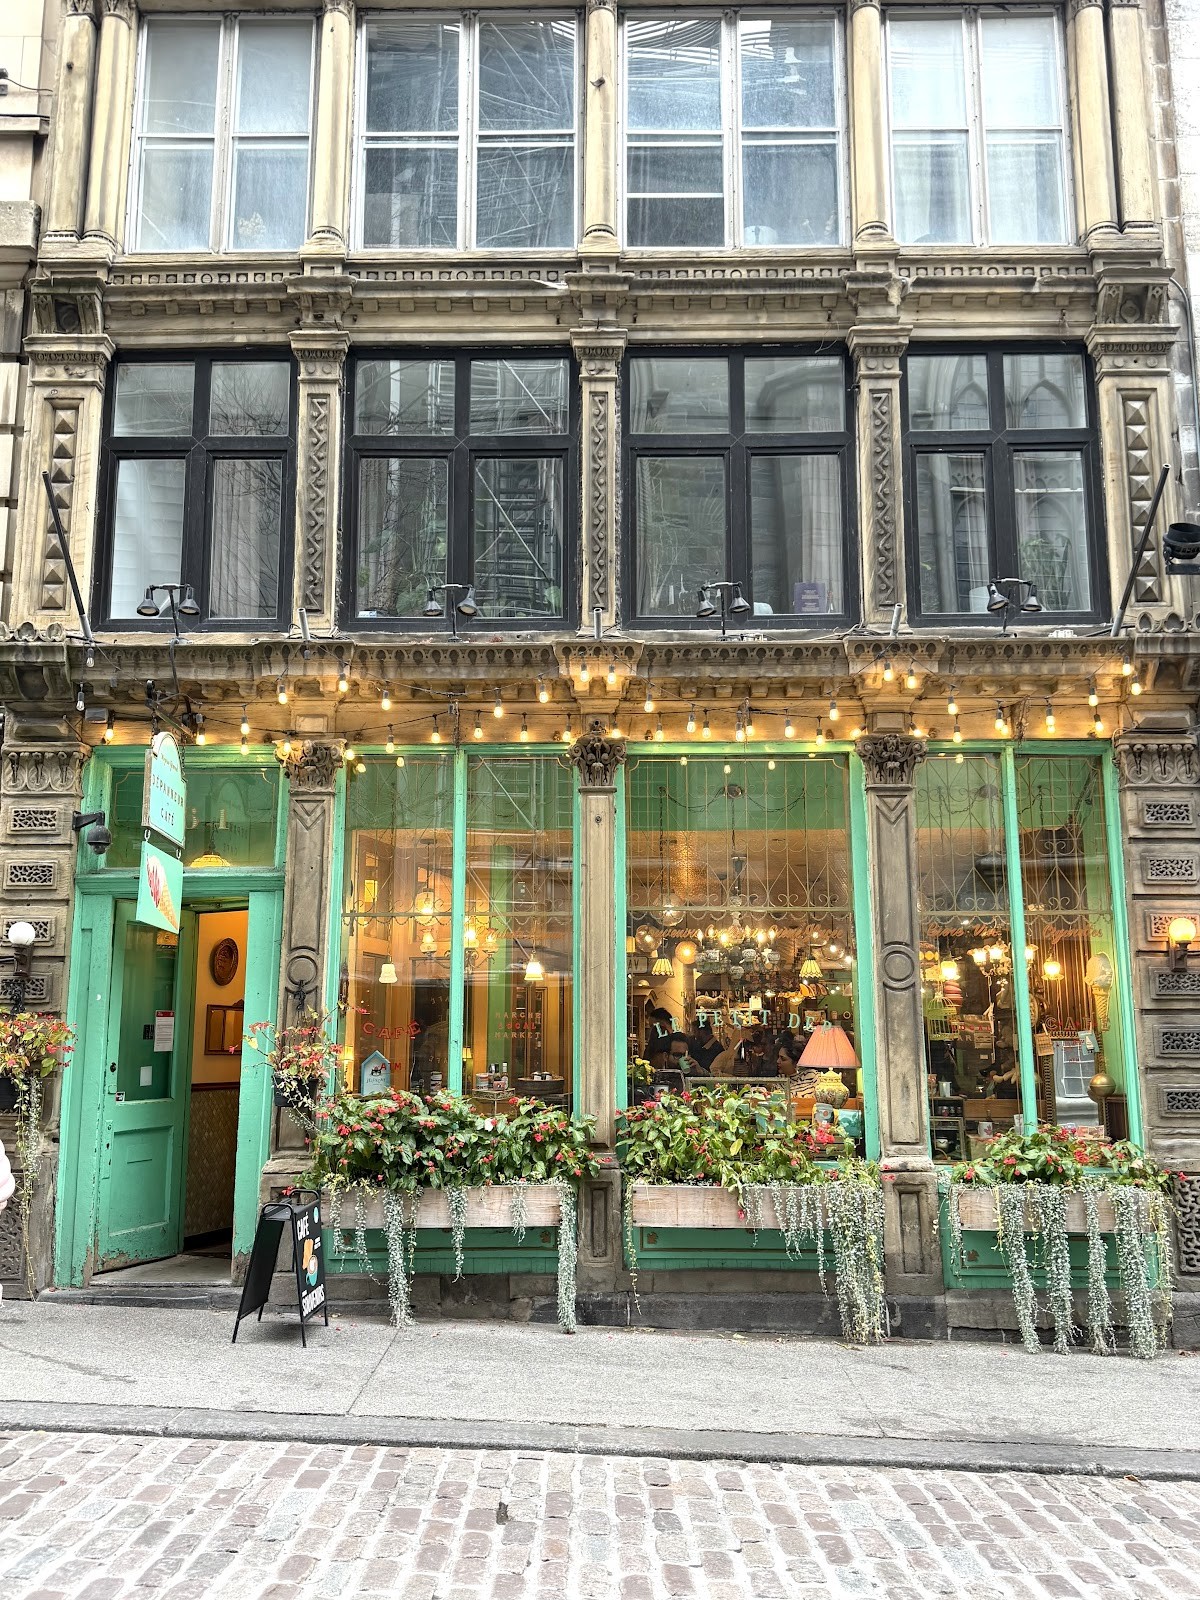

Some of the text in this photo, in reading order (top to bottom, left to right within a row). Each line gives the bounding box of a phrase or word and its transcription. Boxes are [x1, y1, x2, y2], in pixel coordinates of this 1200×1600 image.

[160, 807, 175, 826] CAFÉ
[653, 1017, 683, 1039] LE
[698, 1009, 770, 1029] PETIT
[297, 1211, 310, 1241] CAFÉ
